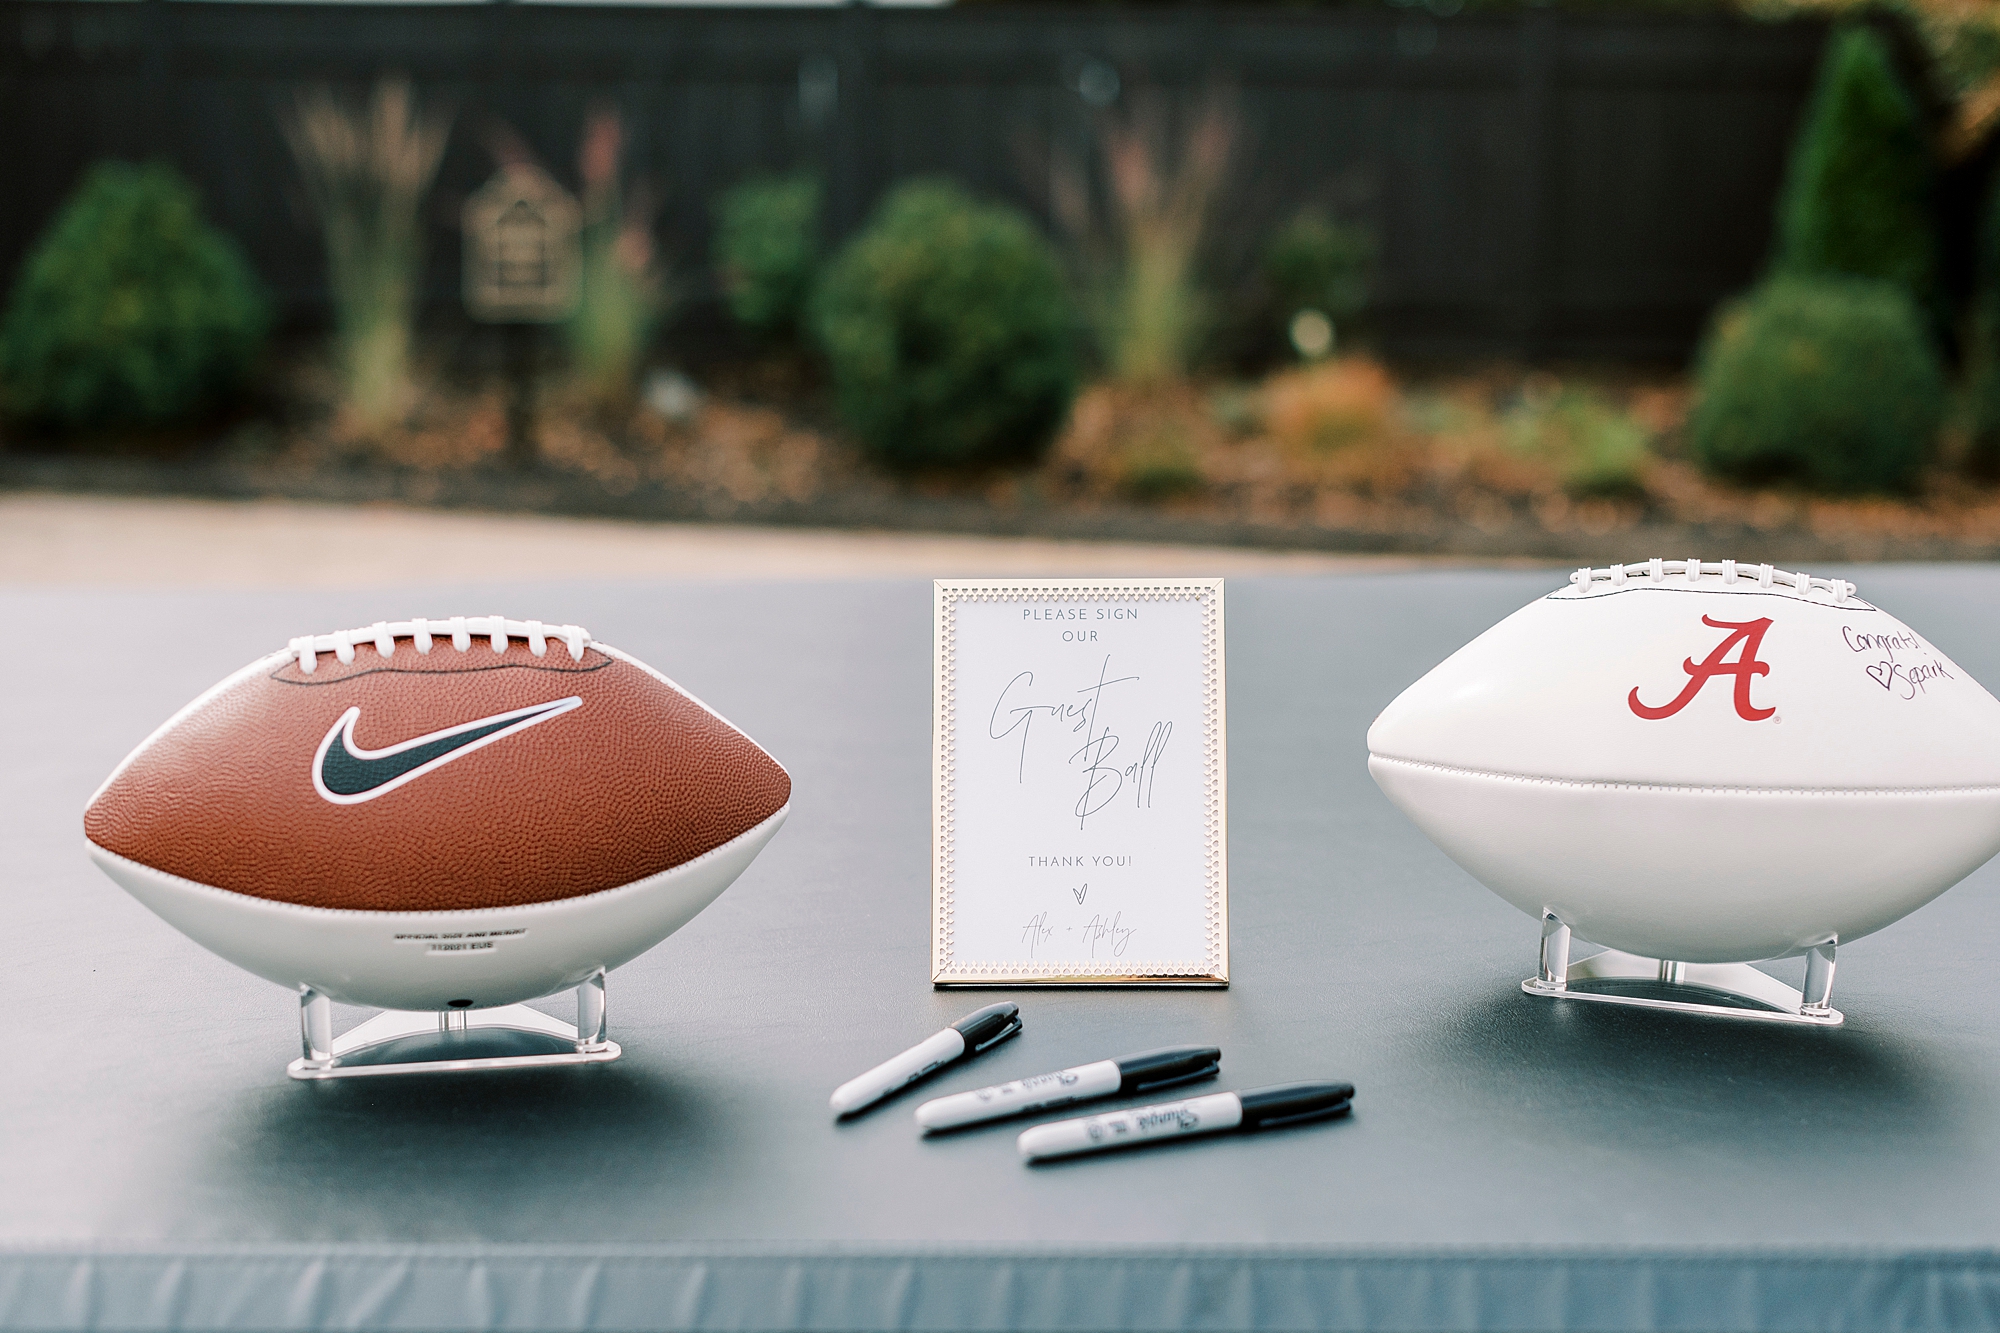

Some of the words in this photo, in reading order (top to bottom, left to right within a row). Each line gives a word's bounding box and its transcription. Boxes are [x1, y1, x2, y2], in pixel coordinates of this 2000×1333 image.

[1022, 608, 1088, 621] PLEASE
[1096, 608, 1139, 621] SIGN
[1061, 630, 1100, 642] OUR
[1841, 625, 1928, 663] Congrats!
[1628, 613, 1777, 722] A
[989, 653, 1140, 784] Guest
[1068, 720, 1173, 831] Ball
[1028, 856, 1085, 868] THANK
[1091, 855, 1133, 867] YOU!
[1021, 911, 1055, 959] Alex
[1081, 911, 1138, 959] Ashley
